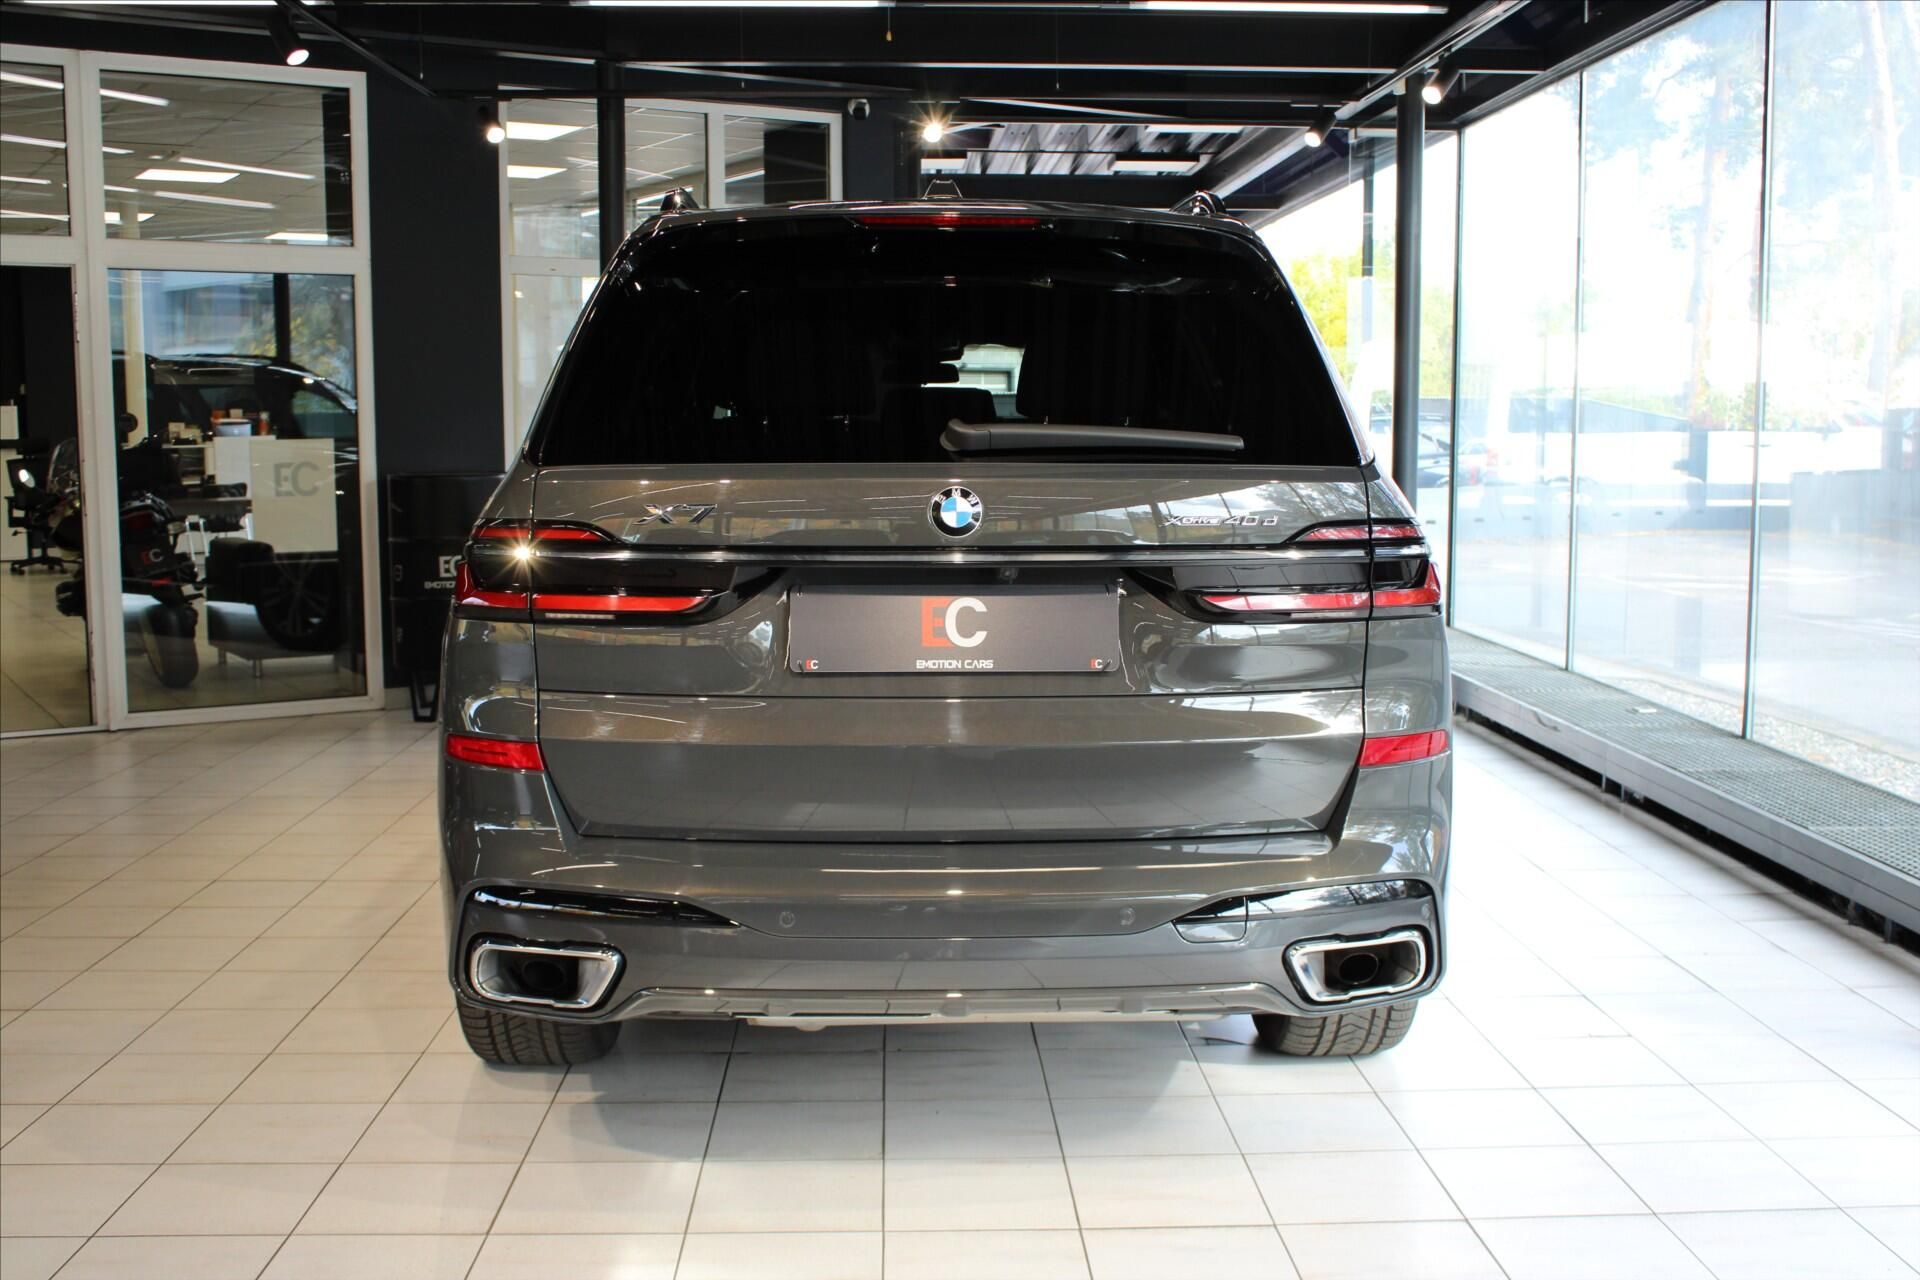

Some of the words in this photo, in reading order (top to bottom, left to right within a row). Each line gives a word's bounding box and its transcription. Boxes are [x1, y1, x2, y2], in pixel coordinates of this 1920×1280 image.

[273, 461, 320, 497] EC
[632, 503, 718, 524] X7
[921, 596, 988, 648] EC
[805, 659, 819, 670] EC
[915, 658, 962, 670] EMOTION
[963, 658, 995, 670] CARS
